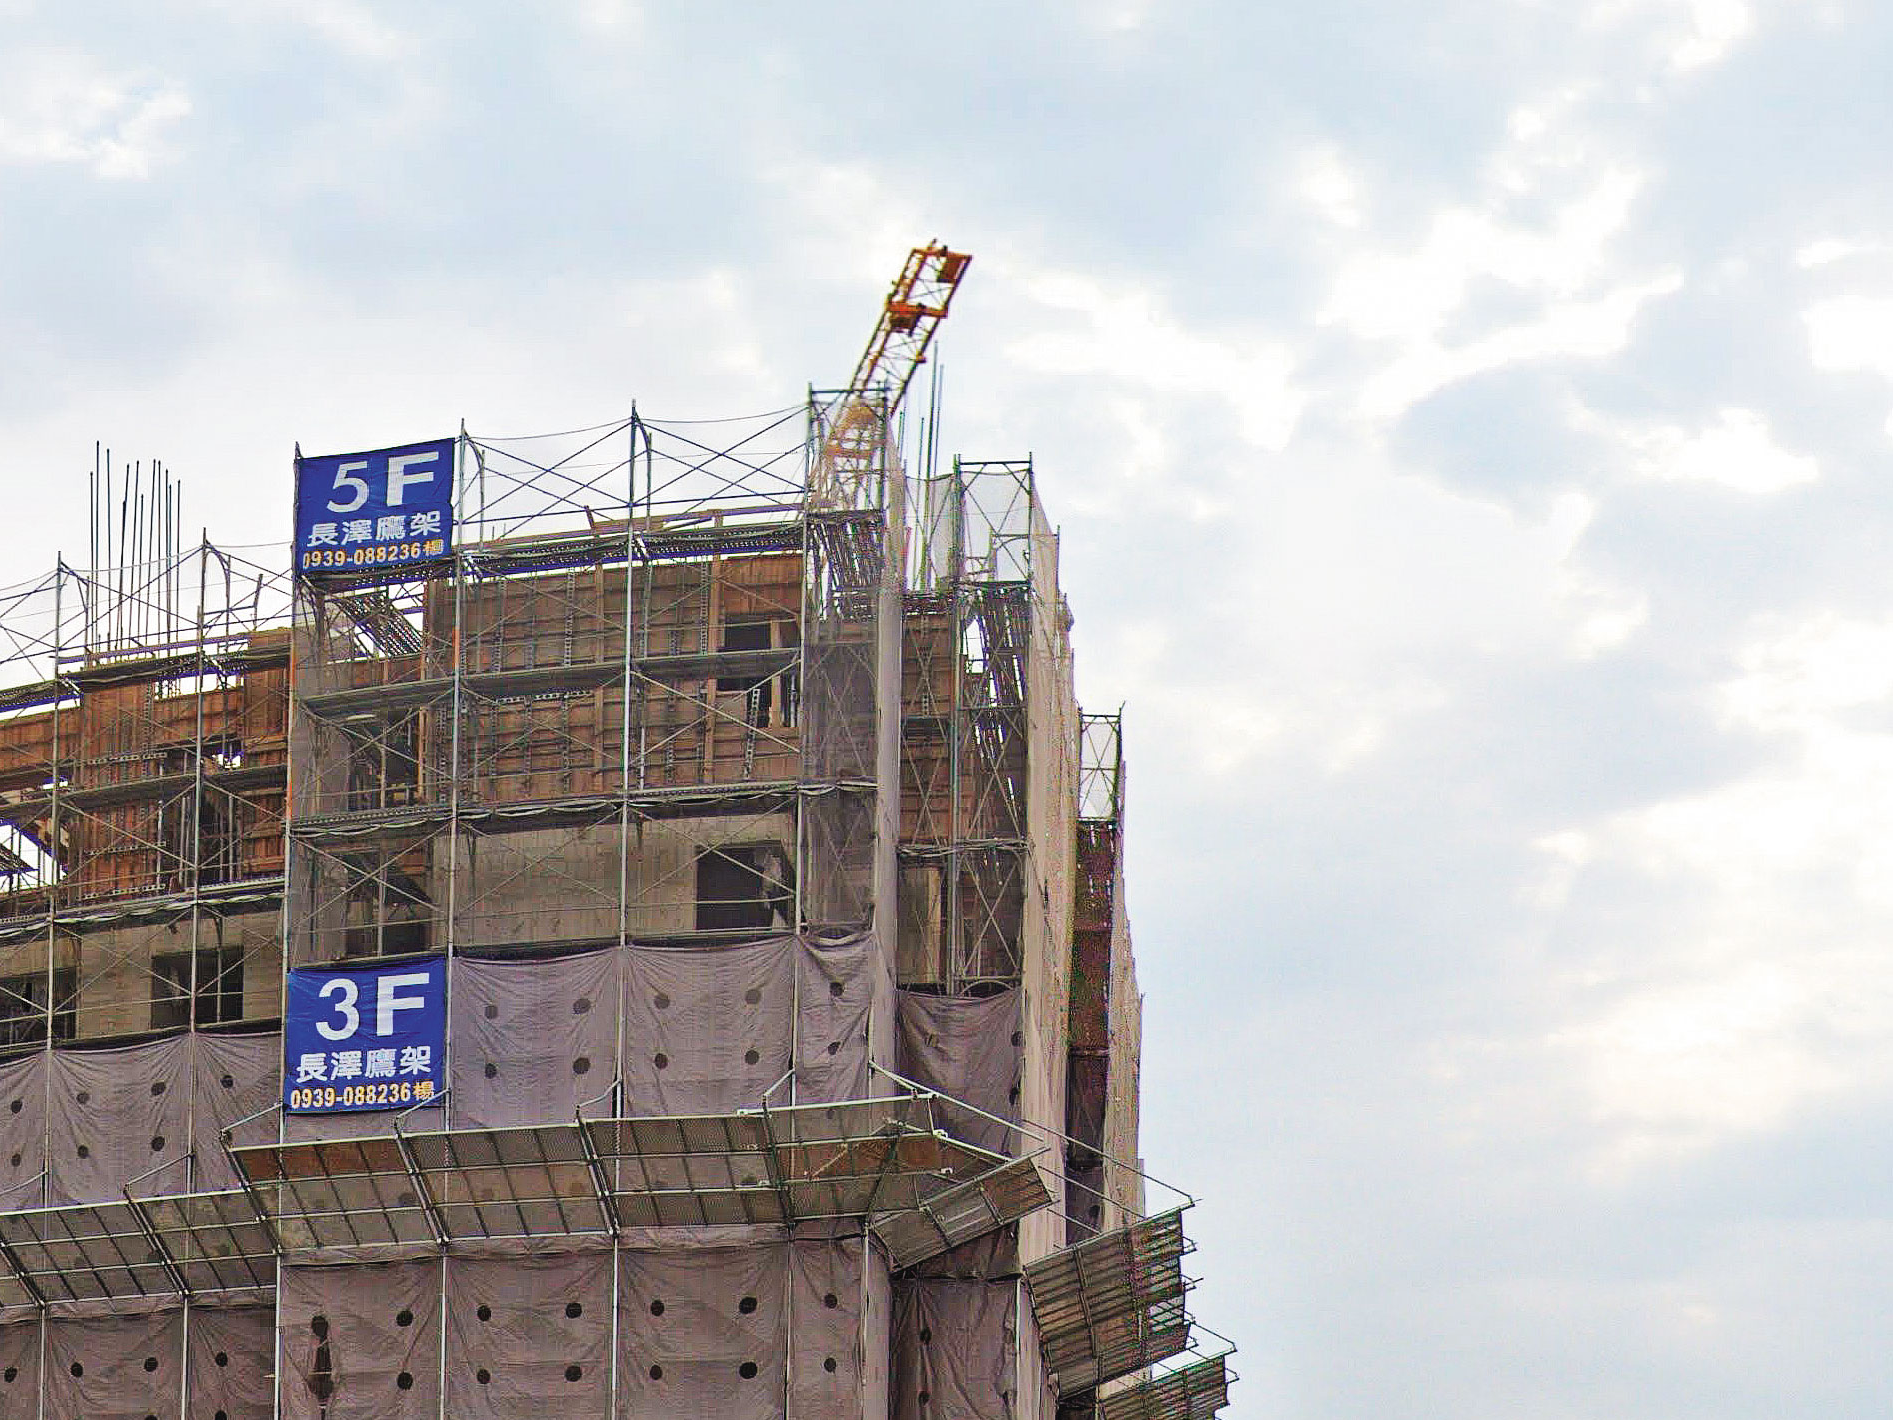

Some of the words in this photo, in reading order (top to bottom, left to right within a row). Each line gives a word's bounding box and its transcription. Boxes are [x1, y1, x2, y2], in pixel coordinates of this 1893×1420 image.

[326, 451, 439, 514] 5F
[306, 510, 441, 547] 長澤鷹架
[315, 972, 430, 1041] 3F
[296, 1045, 431, 1083] 長澤鷹架
